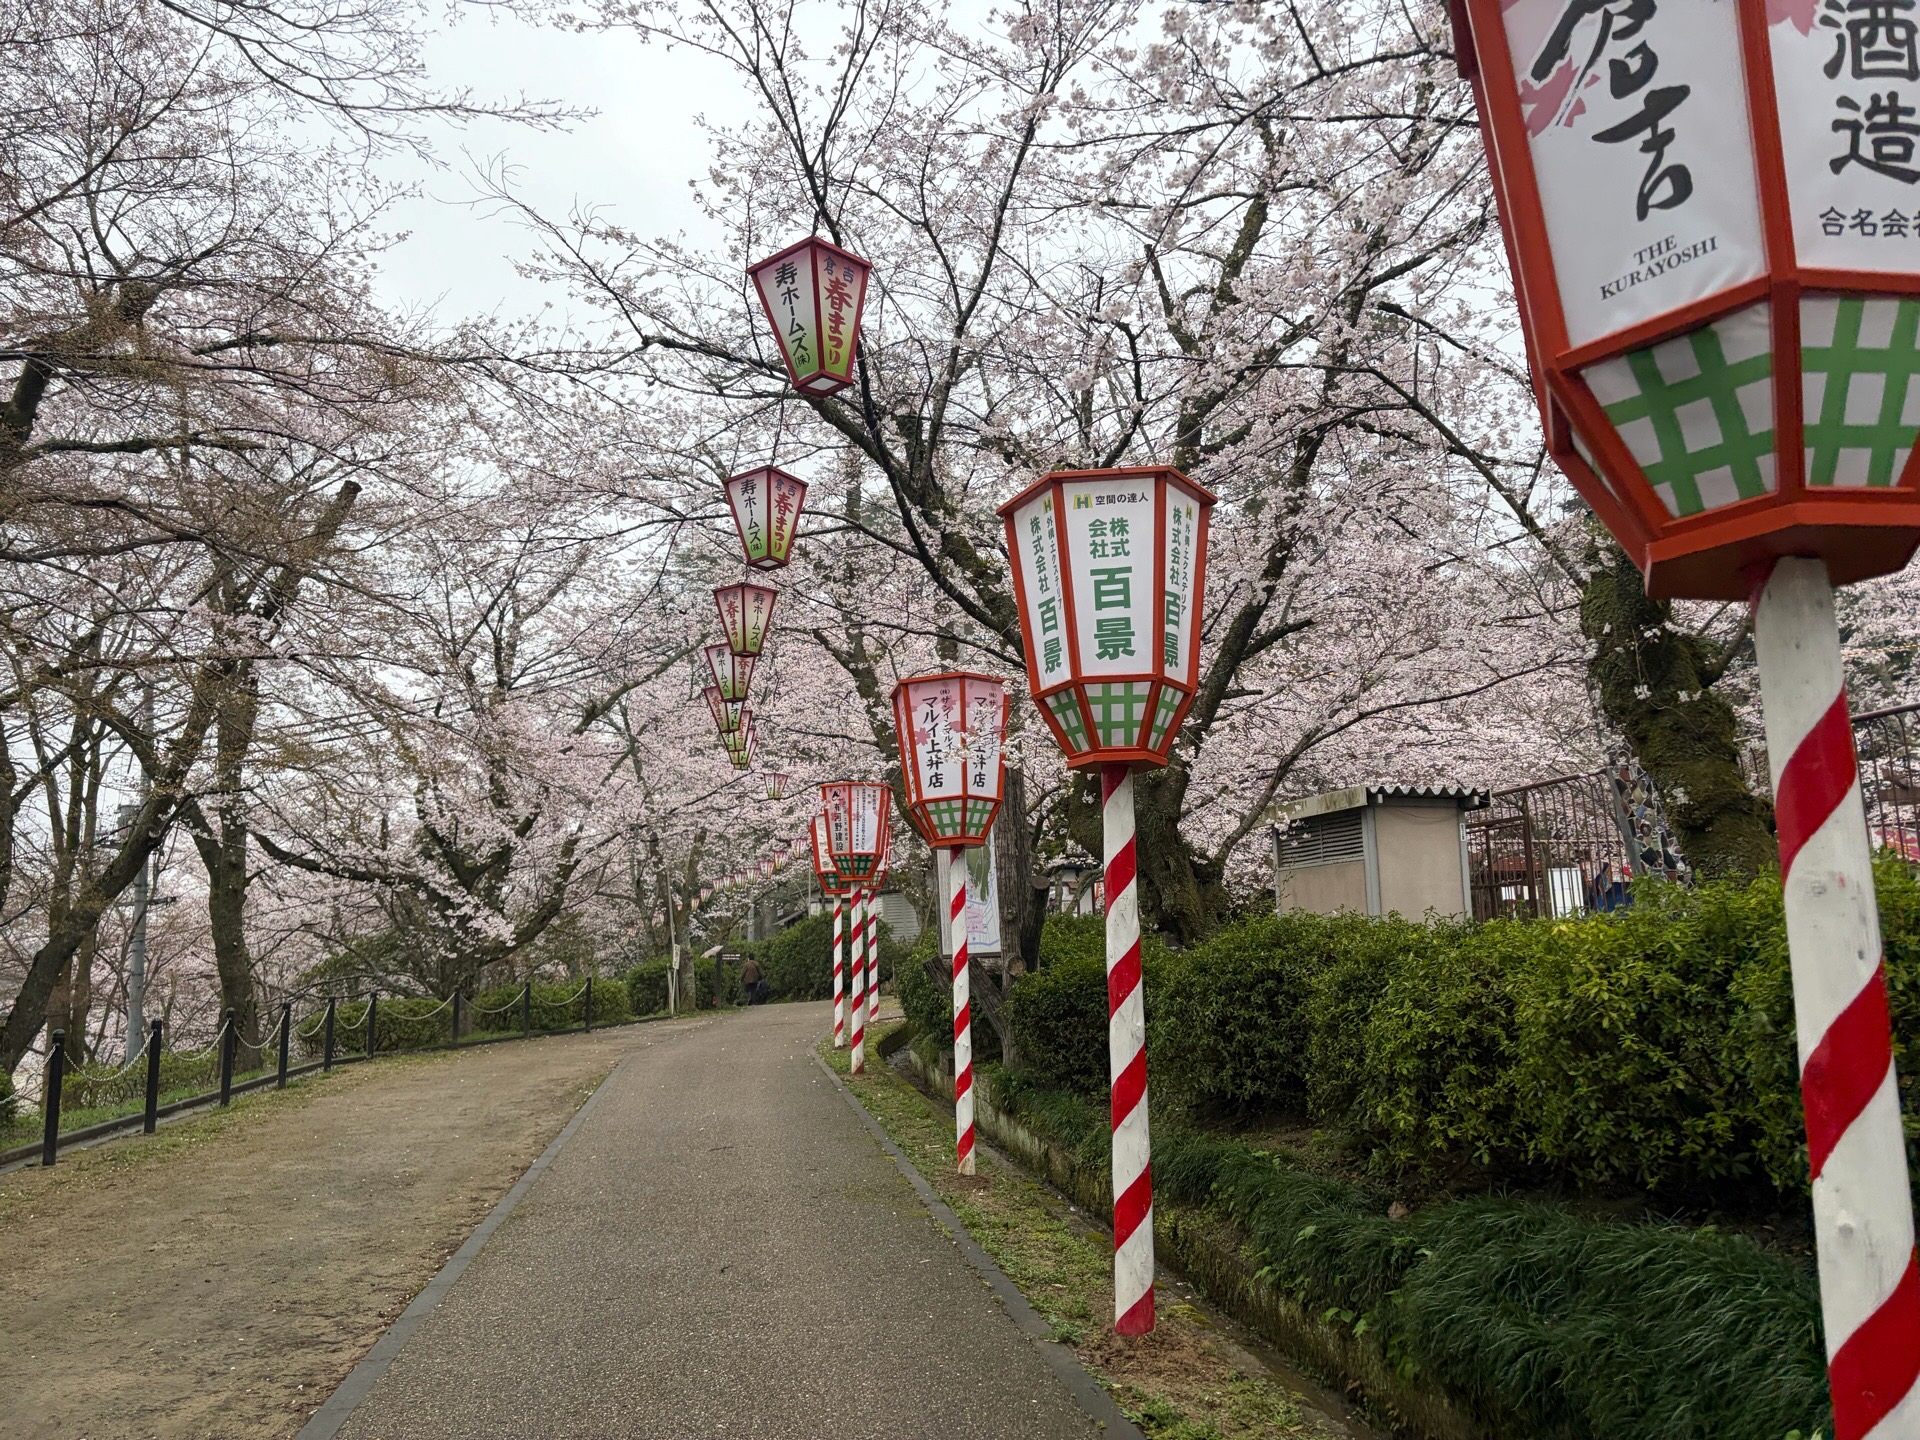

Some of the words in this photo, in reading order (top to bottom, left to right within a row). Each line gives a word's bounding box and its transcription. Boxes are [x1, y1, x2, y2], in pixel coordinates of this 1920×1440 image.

[1600, 236, 1718, 300] KURAYOSHI
[1633, 235, 1678, 265] THE
[824, 276, 853, 365] 春まつり
[774, 492, 794, 552] 春まつり
[1095, 491, 1149, 506] 空間の達人
[1089, 565, 1137, 662] 百景
[922, 695, 944, 789] マルイ上井店
